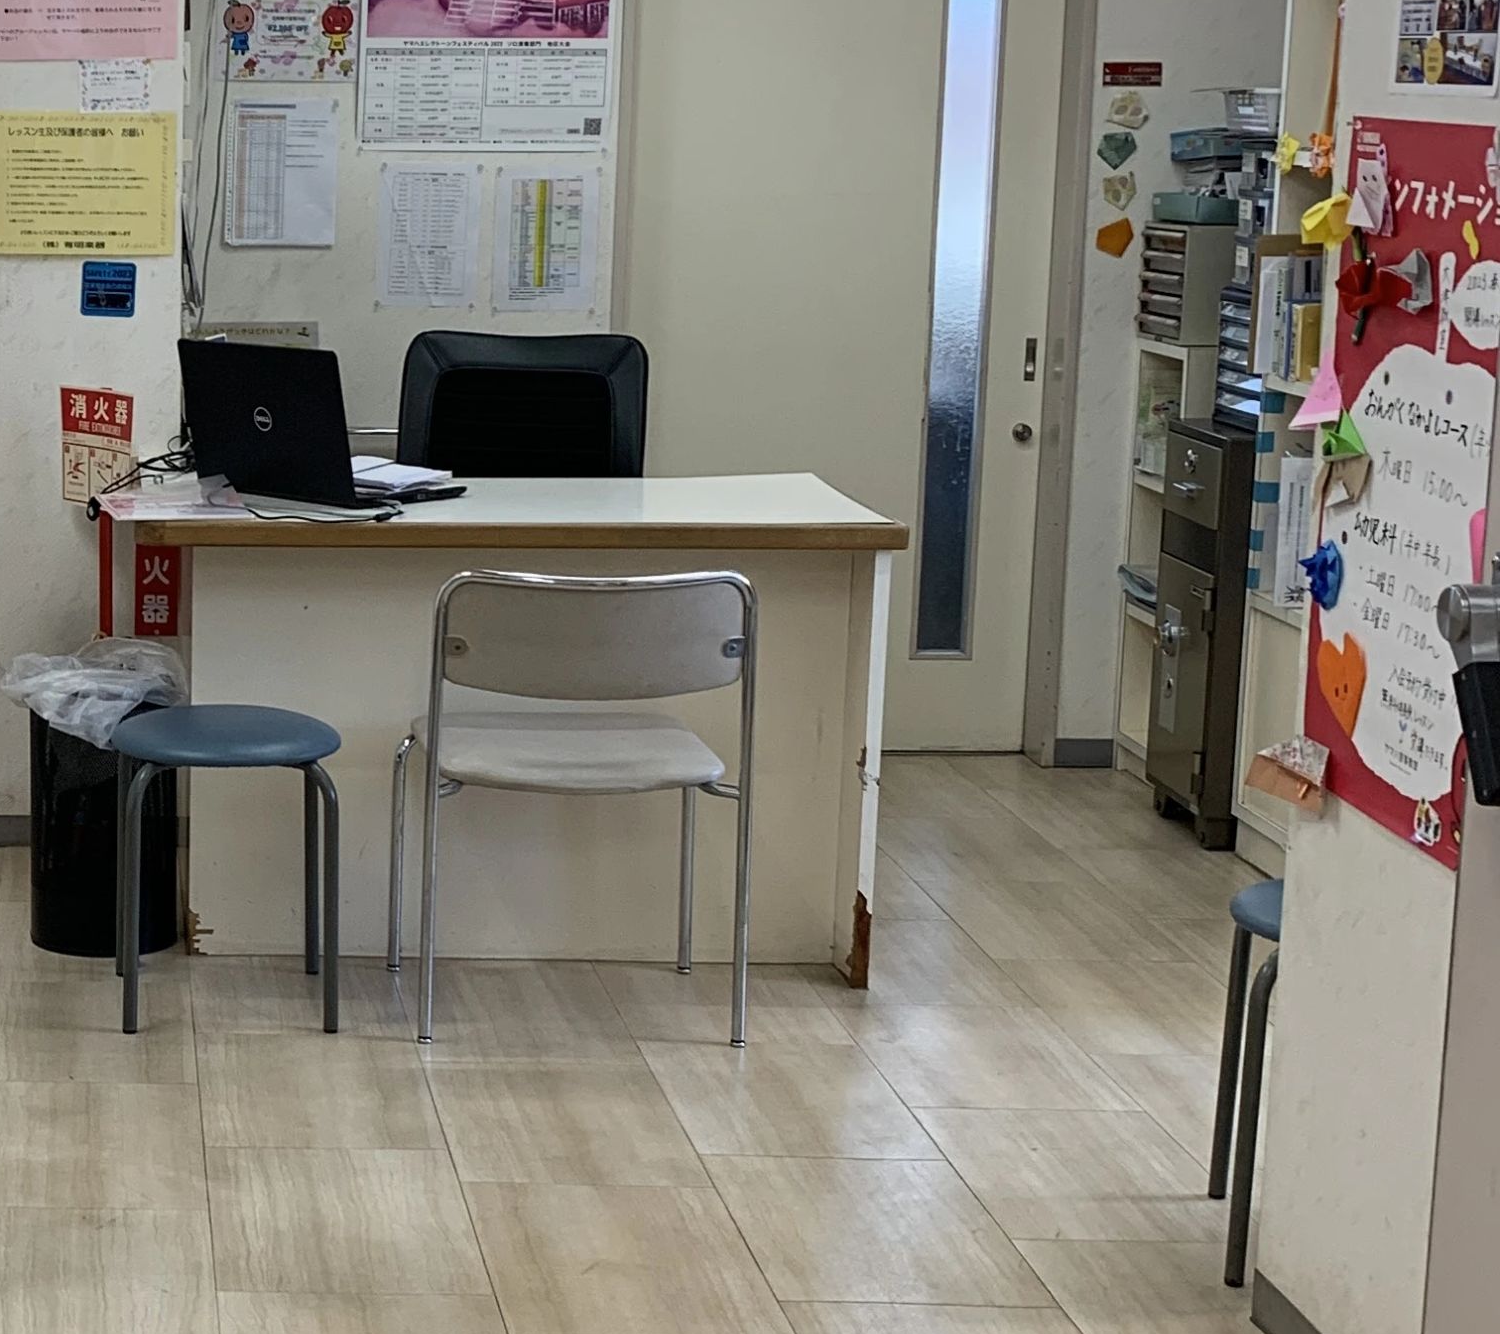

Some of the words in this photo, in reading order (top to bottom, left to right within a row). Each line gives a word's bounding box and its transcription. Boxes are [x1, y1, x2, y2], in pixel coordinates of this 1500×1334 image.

[1394, 178, 1500, 225] ンフォメーシ
[69, 392, 129, 425] 消火器
[142, 555, 170, 624] 火器
